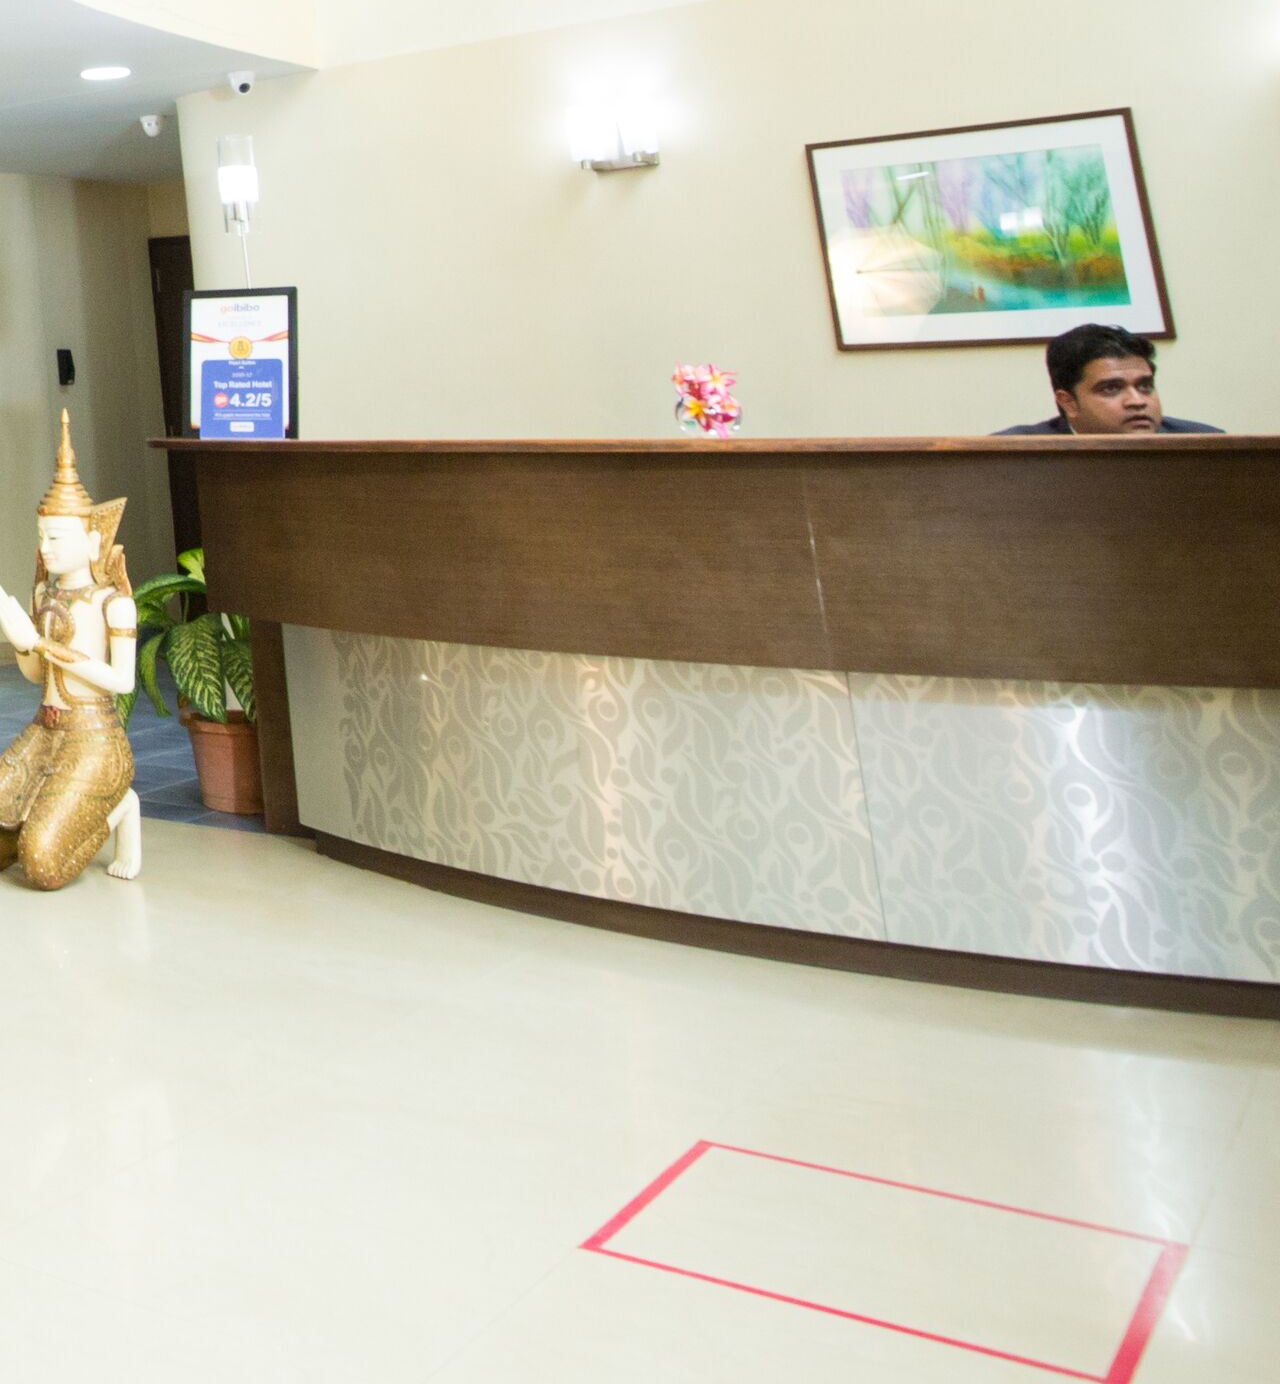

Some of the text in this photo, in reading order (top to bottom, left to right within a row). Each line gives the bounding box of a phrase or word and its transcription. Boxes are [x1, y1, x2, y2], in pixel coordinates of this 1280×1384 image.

[220, 303, 260, 315] goibibo
[213, 380, 273, 390] Top Rated Hotel
[229, 392, 273, 407] 4.2/5
